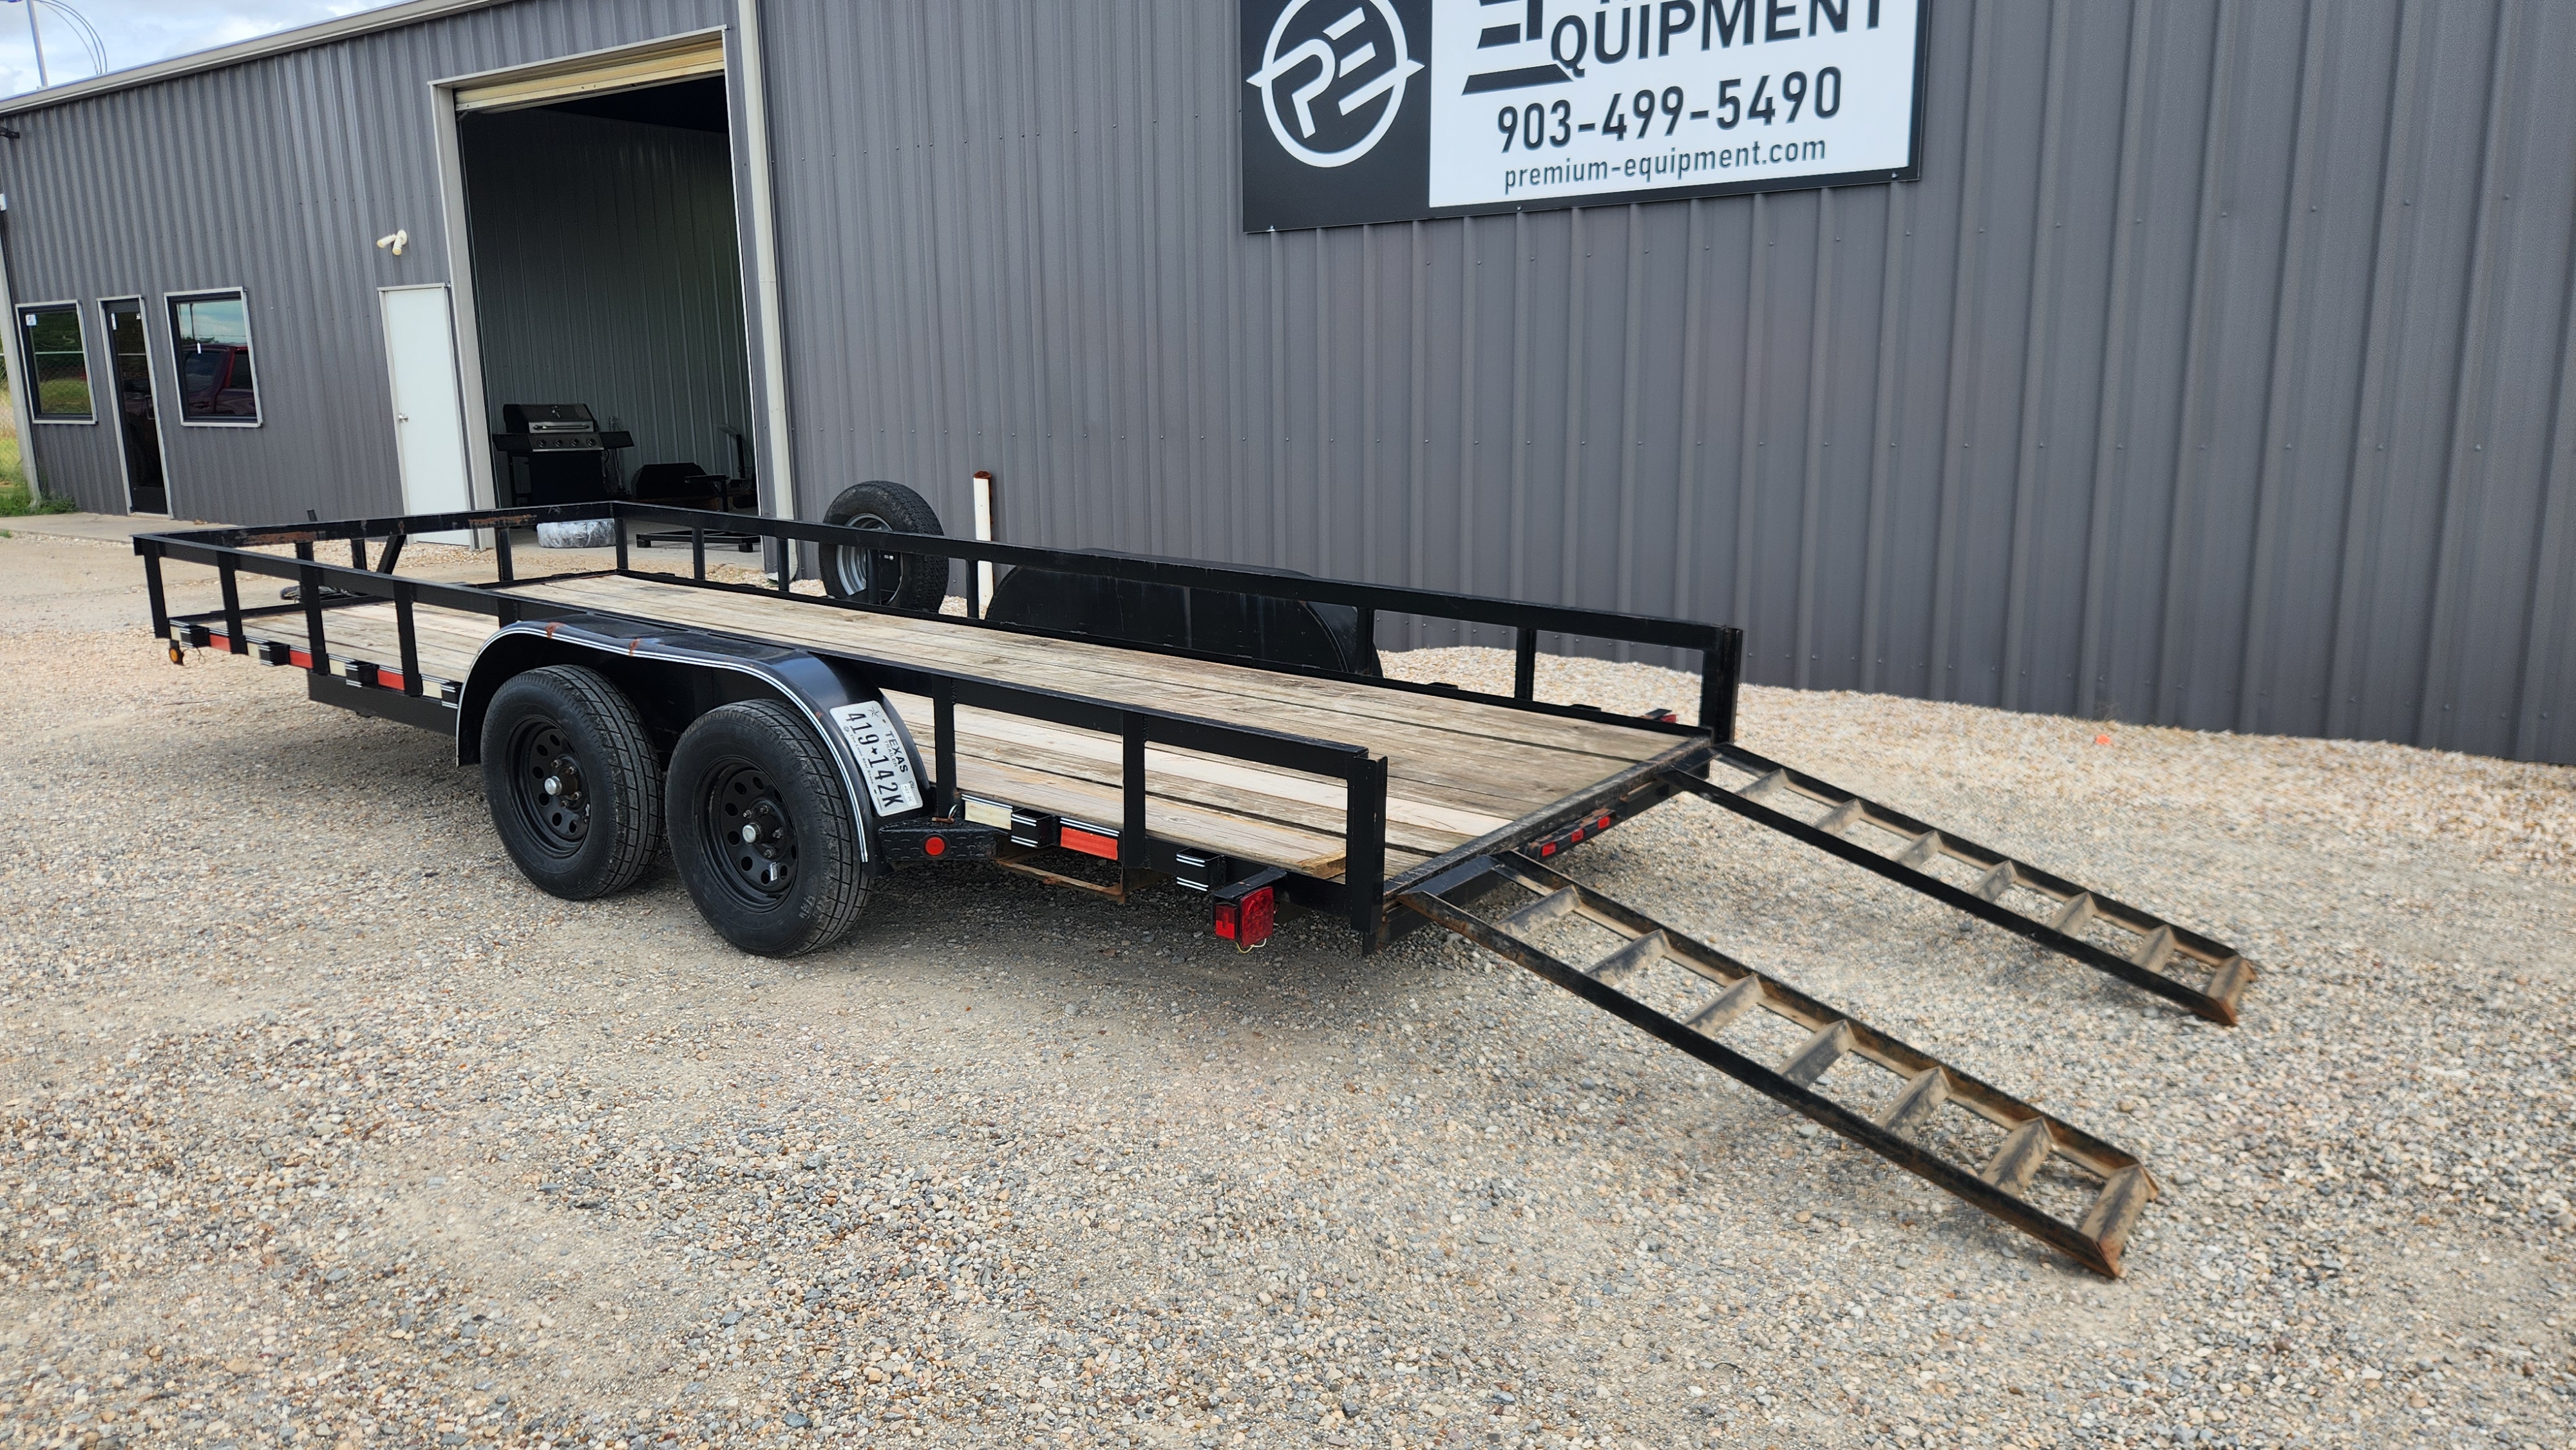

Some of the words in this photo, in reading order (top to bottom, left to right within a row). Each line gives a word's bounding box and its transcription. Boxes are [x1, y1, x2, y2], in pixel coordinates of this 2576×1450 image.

[1497, 66, 1841, 153] 903-499-5490
[1505, 138, 1826, 195] premium-equipment.com
[884, 740, 898, 767] TRAILER
[885, 730, 909, 773] TEXAS
